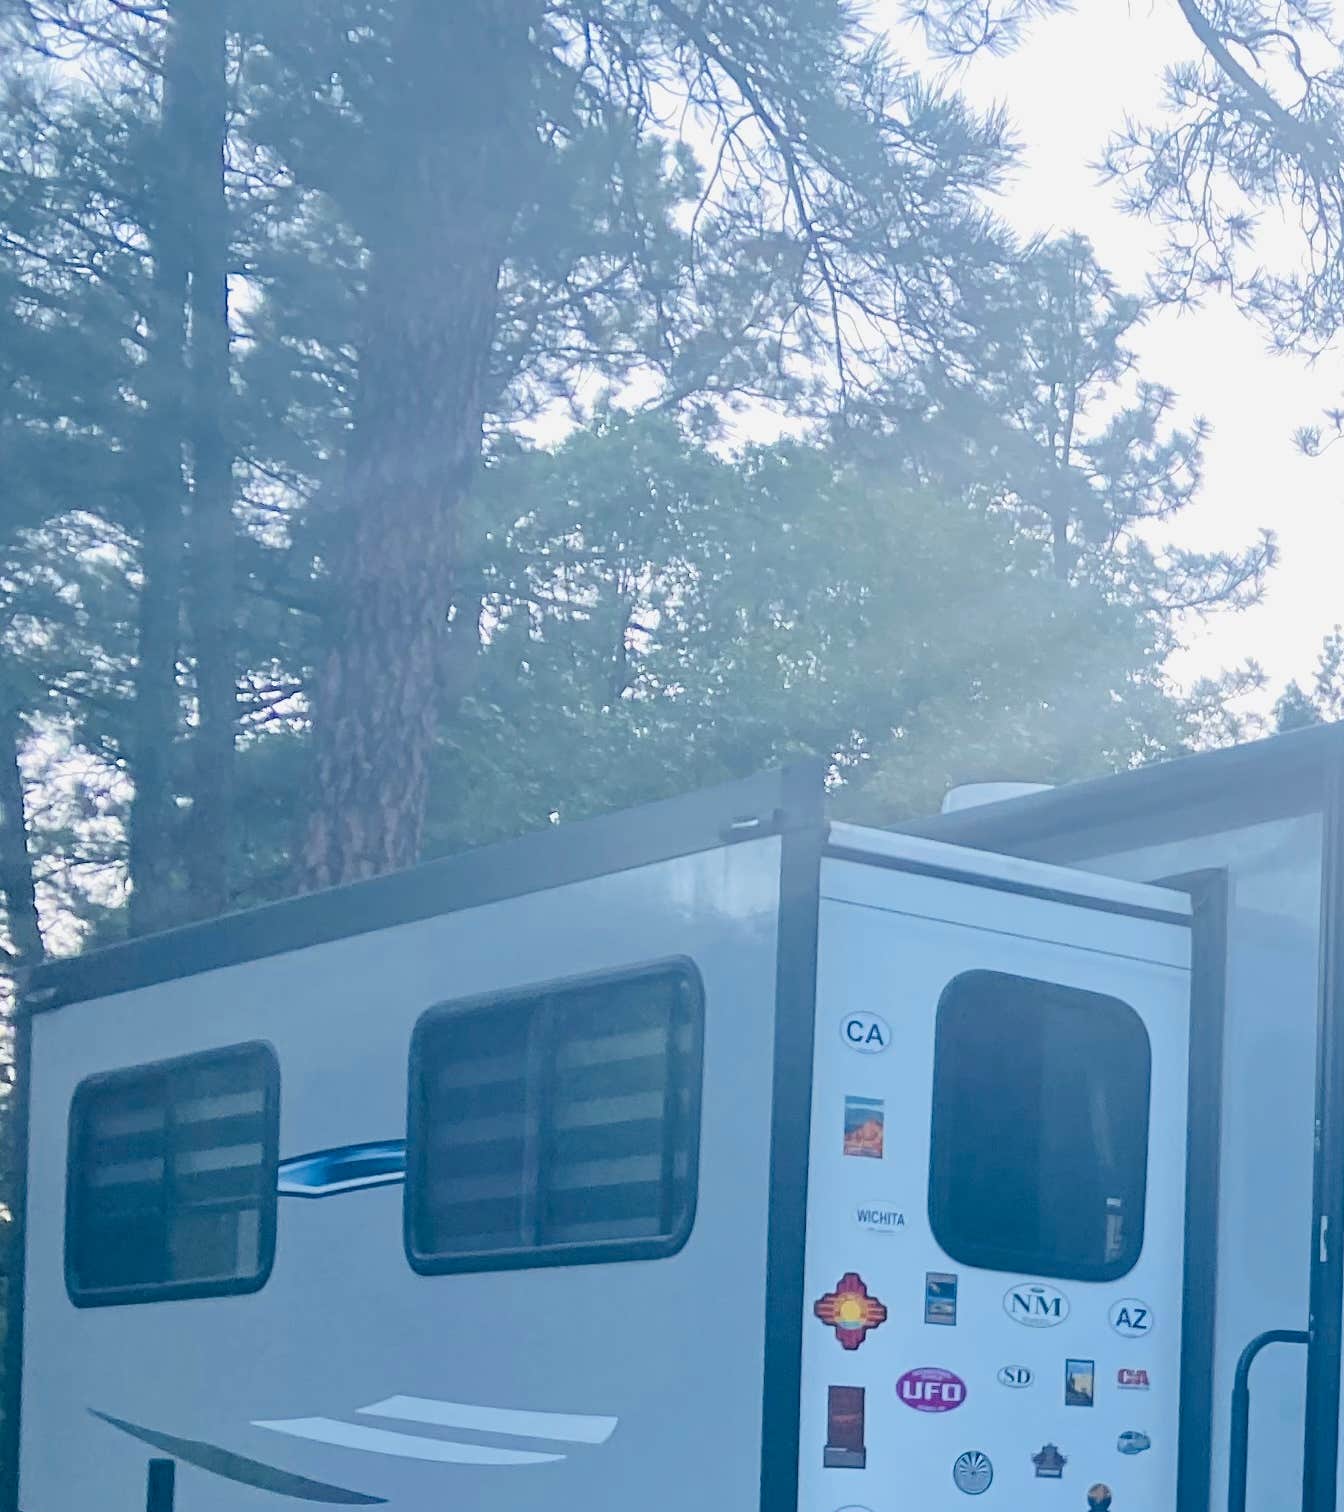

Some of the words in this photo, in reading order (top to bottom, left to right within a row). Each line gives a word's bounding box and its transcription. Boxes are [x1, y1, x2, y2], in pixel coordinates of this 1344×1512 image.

[846, 1020, 885, 1047] CA
[857, 1208, 905, 1227] WICHITA
[1011, 1292, 1062, 1317] NM
[1115, 1307, 1148, 1330] AZ
[1003, 1367, 1031, 1385] SD
[902, 1379, 962, 1402] UFO
